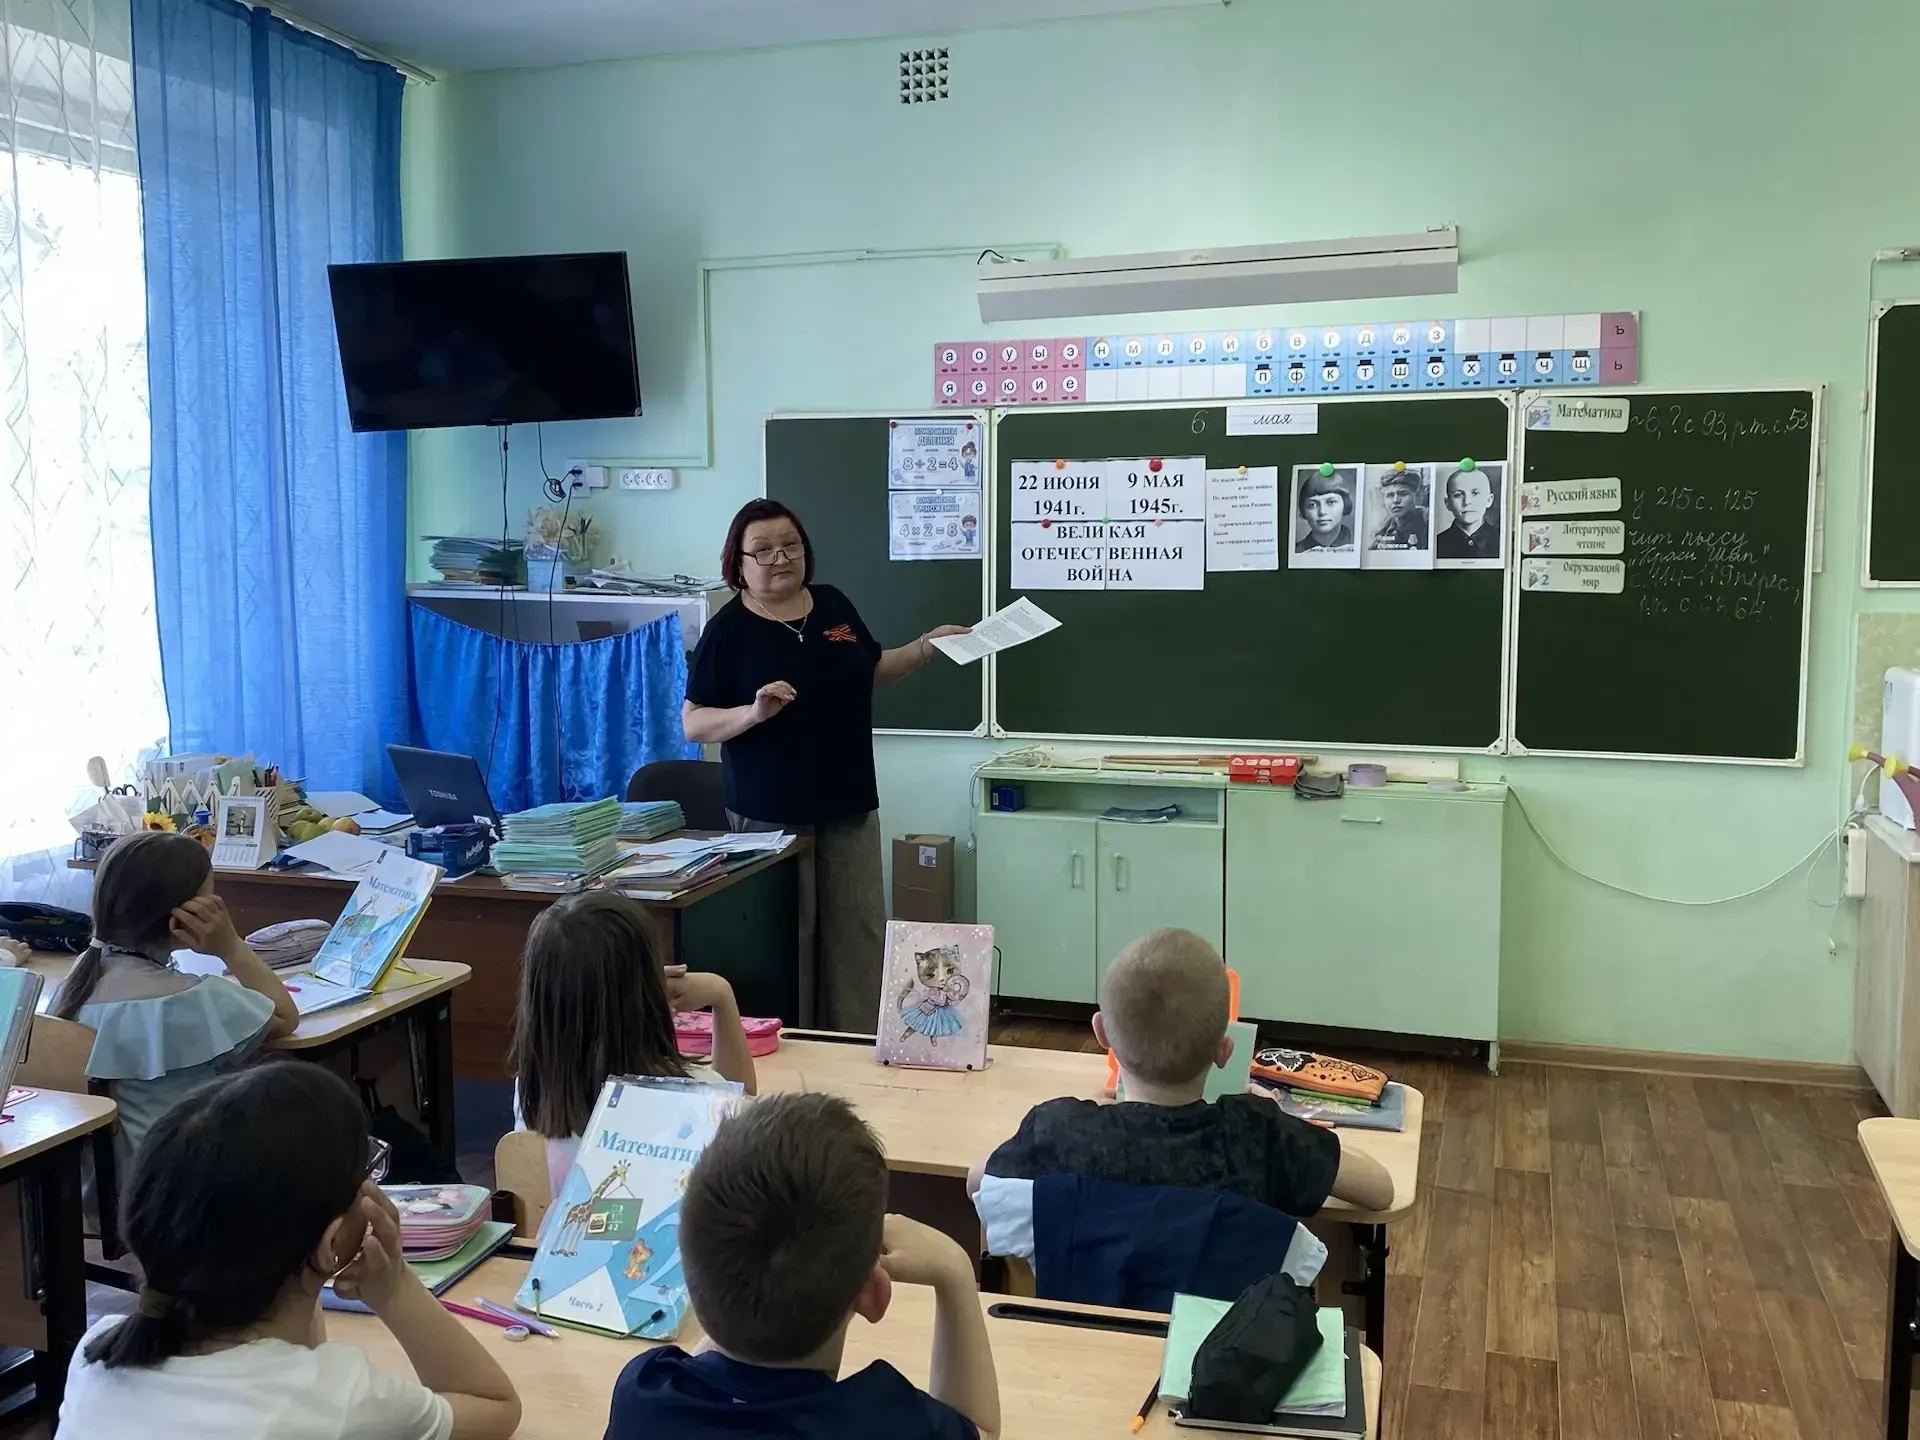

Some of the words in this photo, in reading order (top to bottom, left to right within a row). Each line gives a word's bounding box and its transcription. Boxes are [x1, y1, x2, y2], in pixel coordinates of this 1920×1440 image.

[1556, 403, 1623, 419] Математика
[1191, 409, 1209, 434] 6
[1253, 413, 1293, 425] мая
[1018, 475, 1038, 490] 22
[1043, 476, 1100, 489] ИЮНЯ
[1127, 473, 1138, 488] 9
[1143, 474, 1184, 487] МАЯ
[1546, 488, 1588, 504] Русский
[1589, 488, 1618, 500] язык
[1034, 500, 1085, 515] 1941г.
[1130, 498, 1183, 513] 1945г.
[1576, 539, 1606, 550] чтение
[1021, 547, 1183, 560] ОТЕЧЕСТВЕННАЯ
[1582, 577, 1600, 590] мир
[568, 1296, 596, 1309] Часть
